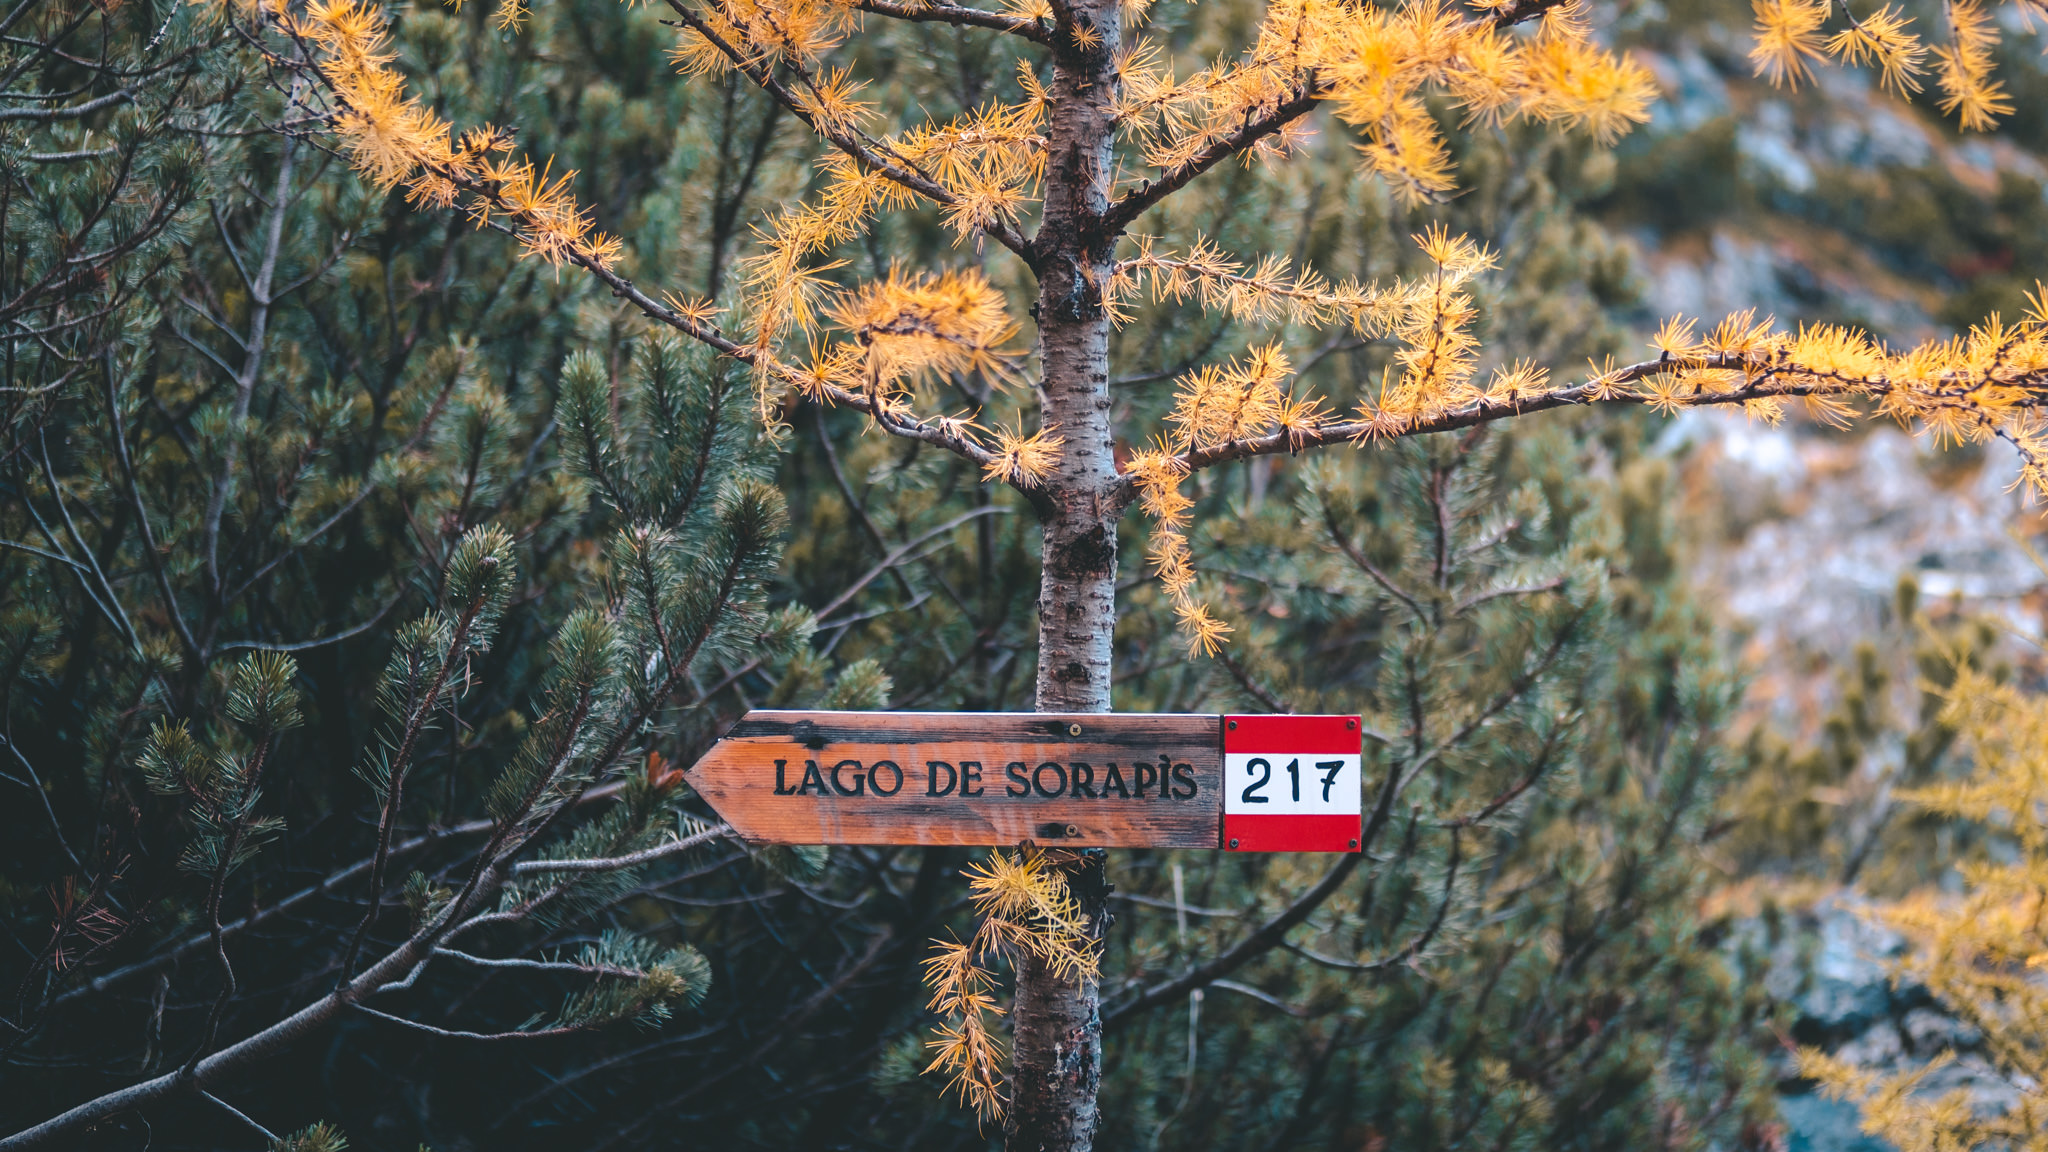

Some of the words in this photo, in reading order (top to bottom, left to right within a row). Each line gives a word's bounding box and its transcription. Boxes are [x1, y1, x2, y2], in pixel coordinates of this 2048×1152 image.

[773, 758, 905, 797] LAGO
[925, 760, 985, 798] DE
[1005, 753, 1198, 802] SORAPÌS
[1240, 757, 1346, 804] 217
